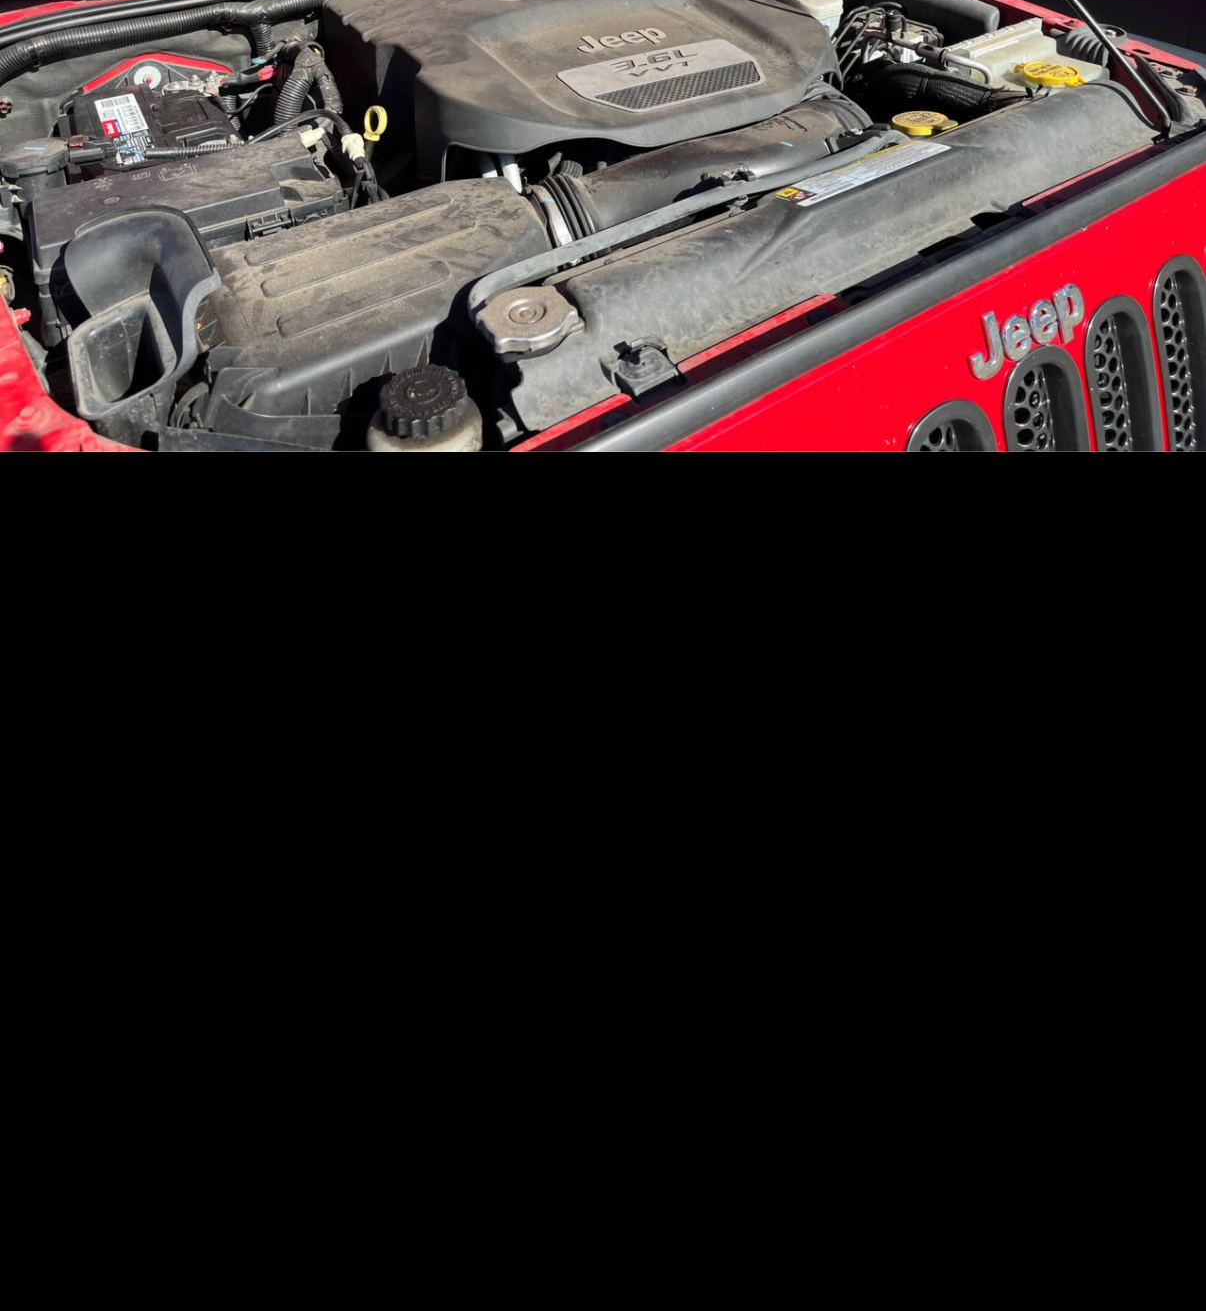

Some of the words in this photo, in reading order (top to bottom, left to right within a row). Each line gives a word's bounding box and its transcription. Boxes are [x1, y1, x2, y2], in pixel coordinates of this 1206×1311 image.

[576, 27, 667, 54] Jeep
[611, 49, 698, 73] 3.6L
[967, 283, 1086, 381] Jeep
